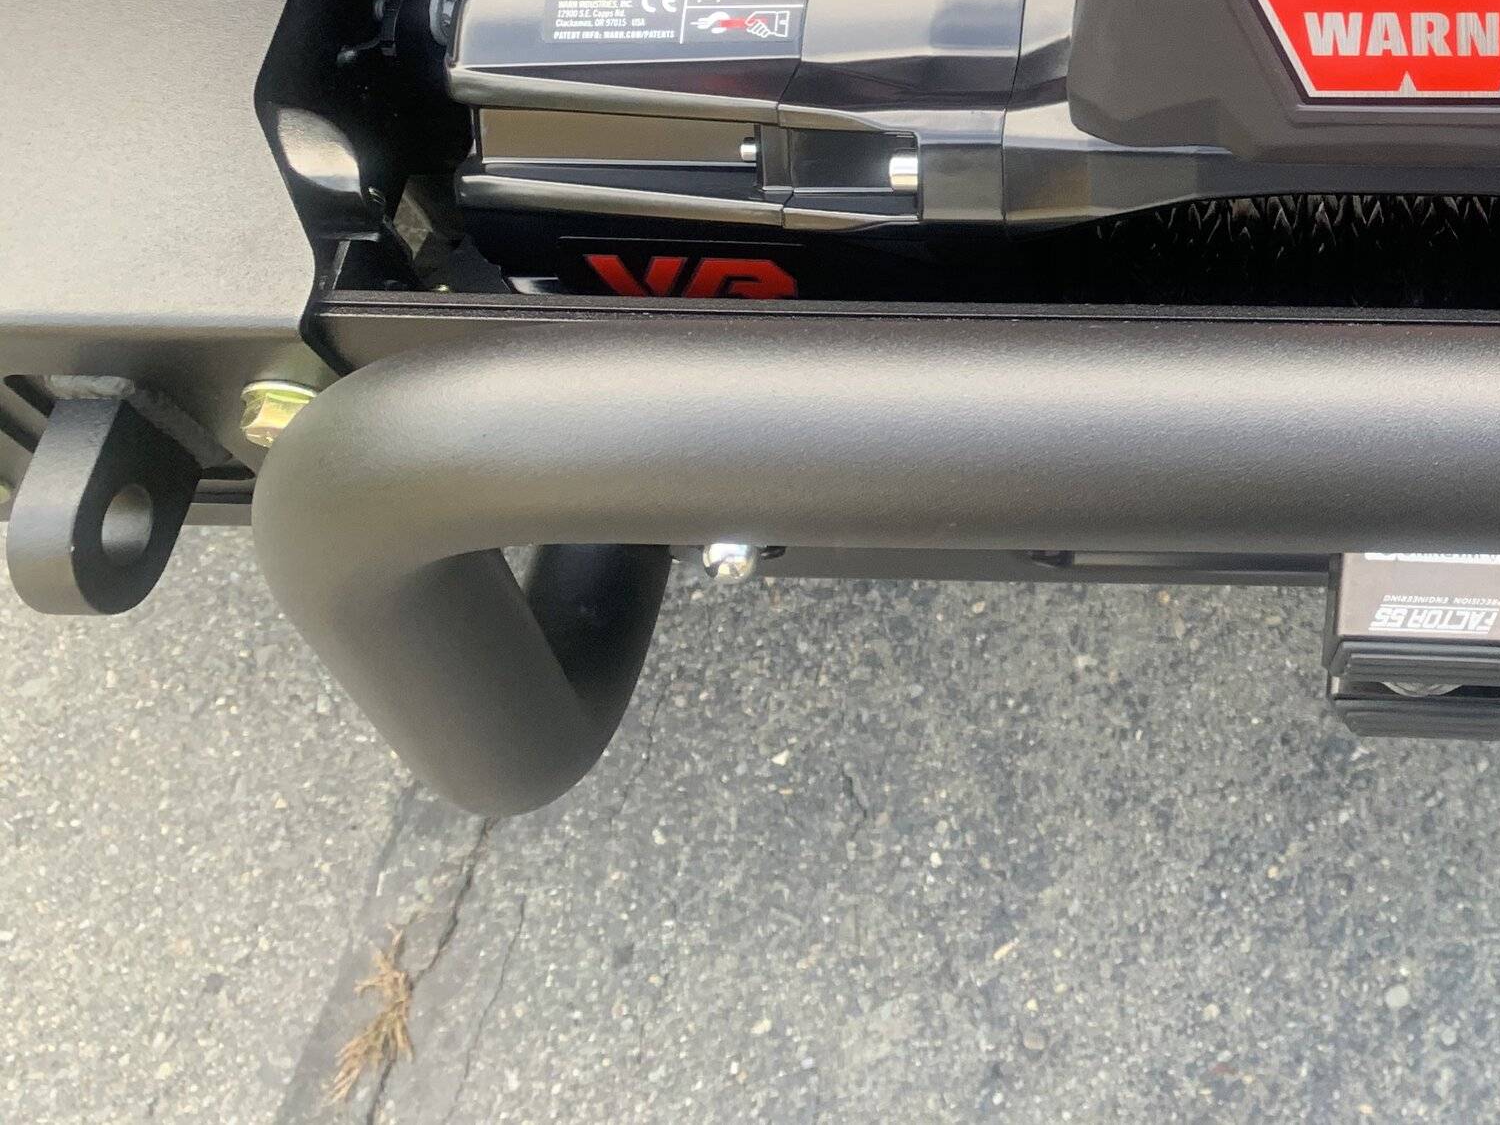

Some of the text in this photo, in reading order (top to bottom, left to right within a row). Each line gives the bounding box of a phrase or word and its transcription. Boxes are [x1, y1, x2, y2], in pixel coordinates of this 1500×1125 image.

[594, 18, 604, 27] OR
[605, 18, 627, 26] 97015
[553, 30, 581, 39] PATENT
[1302, 11, 1500, 57] WARN
[1382, 594, 1449, 604] ENGINEERING
[1370, 607, 1499, 631] FACTOR 55
